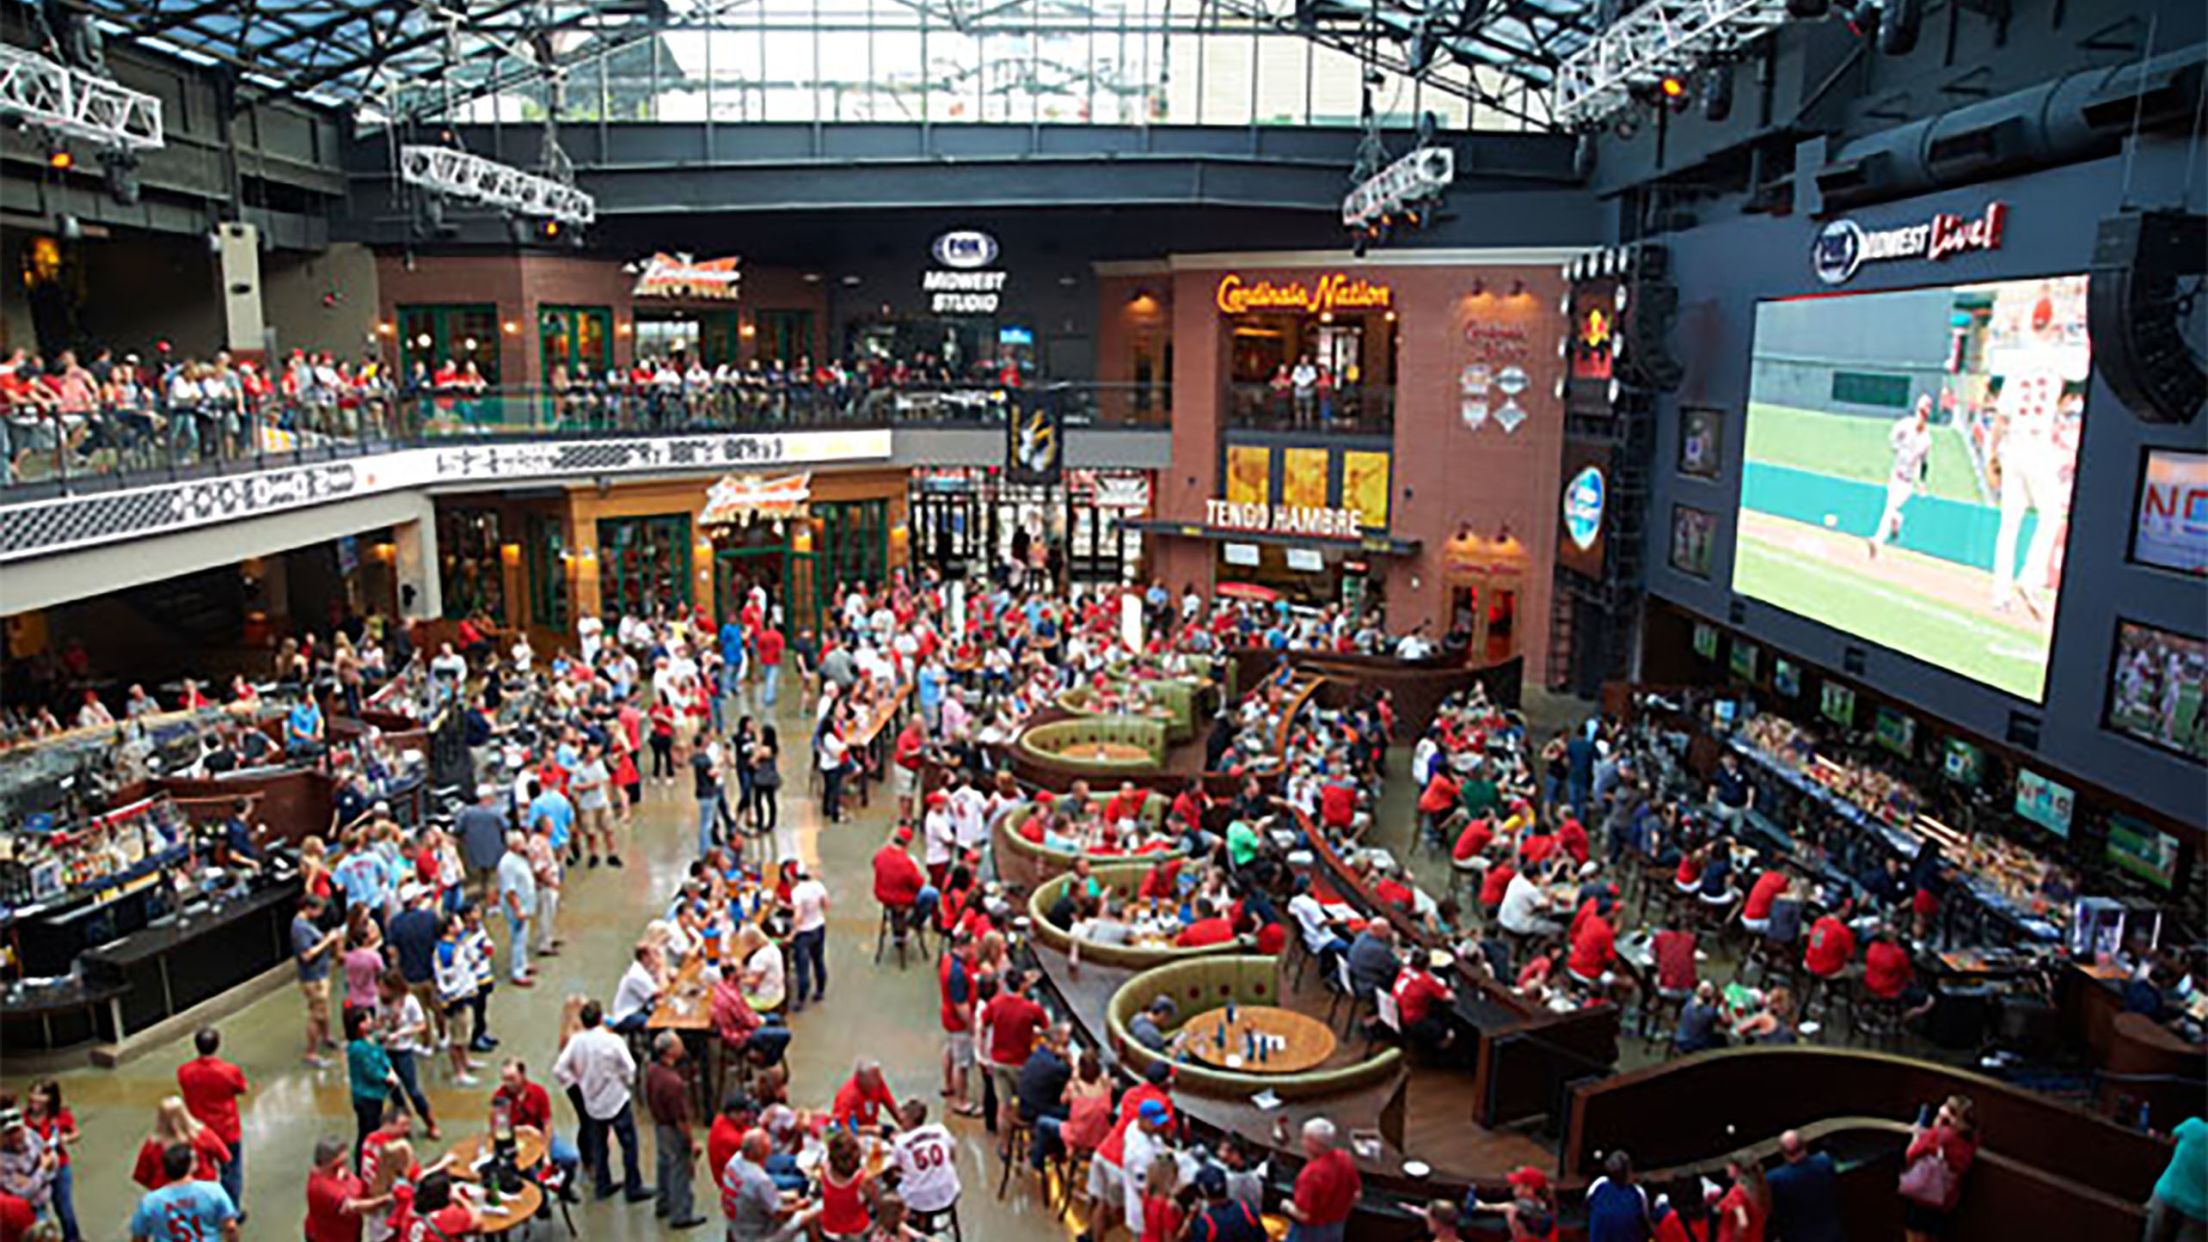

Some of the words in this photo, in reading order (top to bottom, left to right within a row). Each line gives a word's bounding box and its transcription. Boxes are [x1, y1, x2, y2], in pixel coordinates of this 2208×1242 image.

[1927, 201, 2005, 261] Live!
[923, 271, 1007, 291] MIDWEST
[1217, 274, 1309, 313] Cardinals
[1307, 274, 1390, 313] Nation
[932, 293, 998, 312] STUDIO
[1206, 499, 1270, 530] TENGO
[1272, 505, 1363, 537] HAMBRE
[912, 1143, 944, 1171] 50
